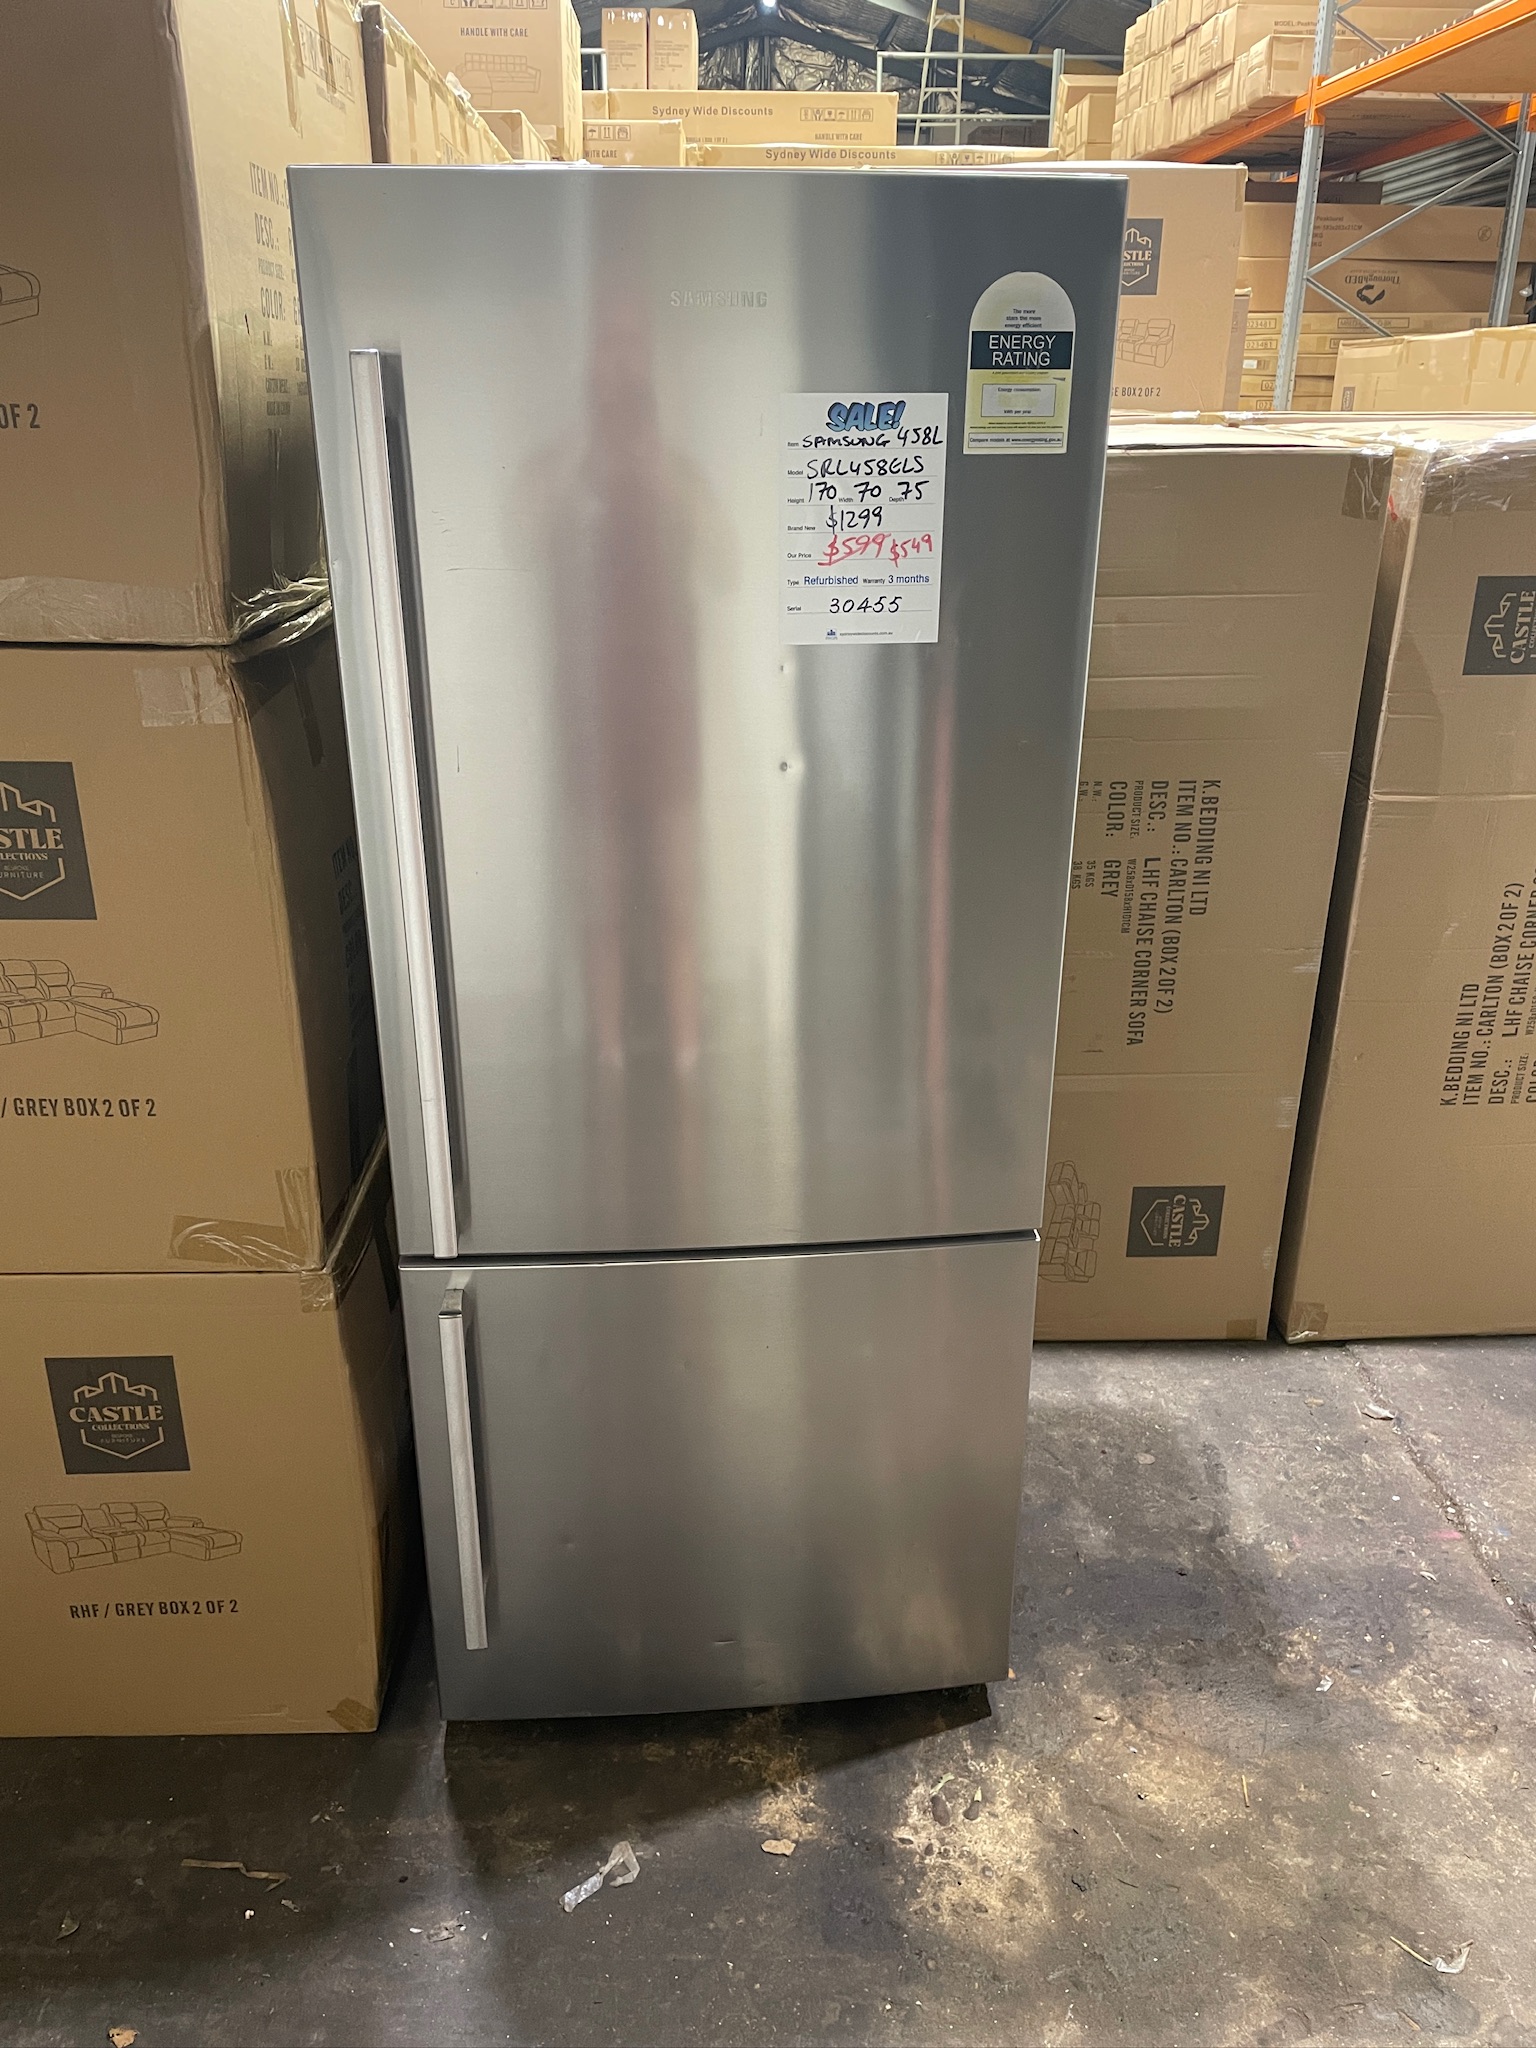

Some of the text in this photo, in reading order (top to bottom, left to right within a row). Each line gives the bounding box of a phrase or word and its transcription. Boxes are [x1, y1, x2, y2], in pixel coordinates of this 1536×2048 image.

[460, 27, 528, 37] HANDLE WITH CARE
[652, 106, 774, 117] Sydney Wide Discounts
[836, 133, 848, 141] WITH
[850, 133, 862, 141] CARE
[585, 149, 617, 158] WITH CARE
[765, 149, 896, 161] Sydney Wide Discounts
[1123, 250, 1152, 261] STLE
[670, 290, 768, 308] SAMSUNG
[989, 334, 1056, 349] ENERGY
[992, 351, 1050, 366] RATING
[1122, 387, 1136, 397] BOX
[1138, 387, 1143, 397] 2
[1145, 387, 1156, 397] OF
[1157, 387, 1161, 396] 2
[27, 403, 41, 429] 2
[826, 400, 906, 432] SALE!
[802, 434, 890, 448] SAMSUNG
[898, 425, 943, 447] 458L
[808, 481, 837, 503] 170
[854, 481, 882, 503] 70
[898, 480, 930, 501] 75
[826, 505, 883, 535] $1299
[889, 533, 932, 568] $549
[803, 576, 859, 585] Refurbished
[888, 575, 894, 583] 3
[896, 574, 930, 583] months
[829, 596, 902, 613] 30455
[1510, 591, 1536, 664] CASTLE
[1132, 780, 1144, 818] PRODUCT
[1175, 780, 1197, 816] ITEM
[0, 828, 64, 849] STLE
[1100, 781, 1128, 897] COLOR: GREY
[1172, 822, 1192, 854] NO.:
[1189, 780, 1221, 915] K.BEDDING NI LTD
[0, 852, 48, 861] LECTIONS
[1073, 861, 1083, 870] 38
[1086, 860, 1096, 870] 35
[1071, 874, 1081, 889] KGS
[1085, 872, 1095, 888] KGS
[1165, 858, 1188, 924] CARLTON
[1504, 883, 1525, 898] 2)
[1126, 780, 1169, 1045] DESC.: LHF CHAISE CORNER SOFA
[1500, 902, 1518, 919] OF
[1160, 930, 1181, 963] (BOX
[1489, 934, 1512, 969] (BOX
[1509, 953, 1534, 1005] CHAISE
[1153, 999, 1173, 1014] 2)
[1477, 975, 1504, 1036] CARLTON
[1502, 1008, 1523, 1037] LHF
[1440, 983, 1480, 1106] K.BEDDING NI LTD
[1470, 1039, 1491, 1071] NO.:
[1463, 1074, 1484, 1105] ITEM
[1488, 1059, 1513, 1105] DESC.:
[1510, 1072, 1524, 1104] PRODUCT
[1, 1097, 157, 1118] / GREY BOX 2 OF 2
[1168, 1194, 1187, 1247] CASTLE
[69, 1405, 164, 1423] CASTLE
[91, 1422, 150, 1431] COLLECTIONS
[70, 1599, 239, 1618] RHF / GREY BOX 2 OF 2
